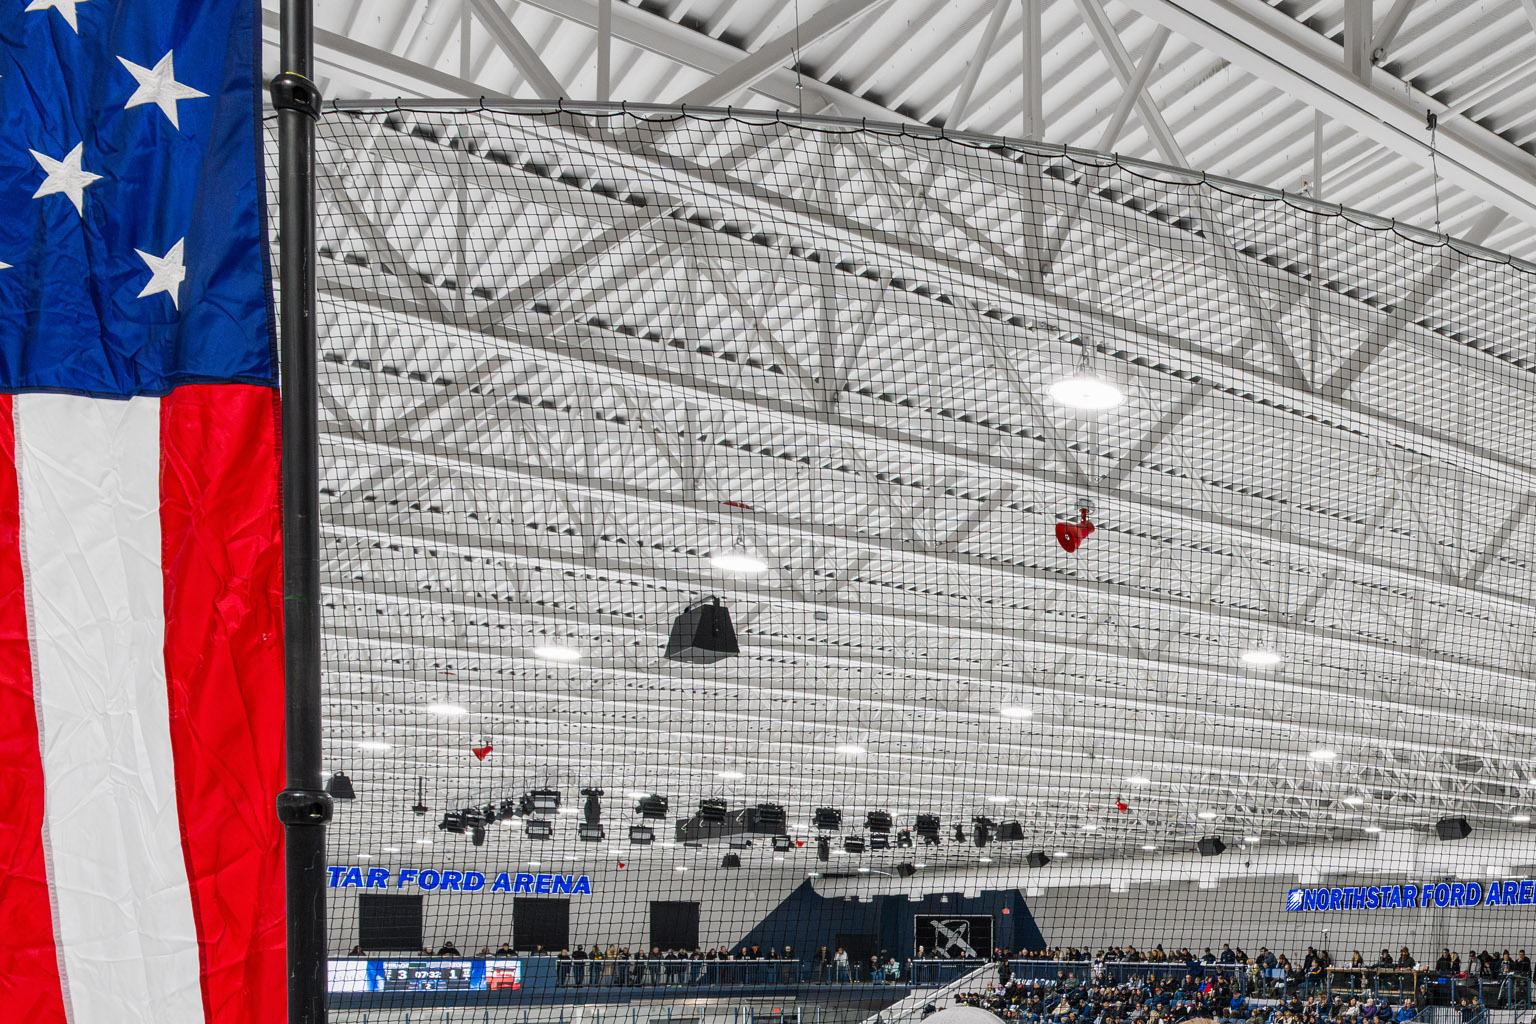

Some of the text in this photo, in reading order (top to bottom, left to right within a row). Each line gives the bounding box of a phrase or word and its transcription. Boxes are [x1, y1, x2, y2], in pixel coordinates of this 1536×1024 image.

[327, 866, 592, 895] TAR FORD ARENA
[1303, 884, 1418, 912] NORTHSTAR
[1421, 882, 1485, 908] FORD
[397, 970, 408, 980] 3
[448, 969, 458, 980] 1
